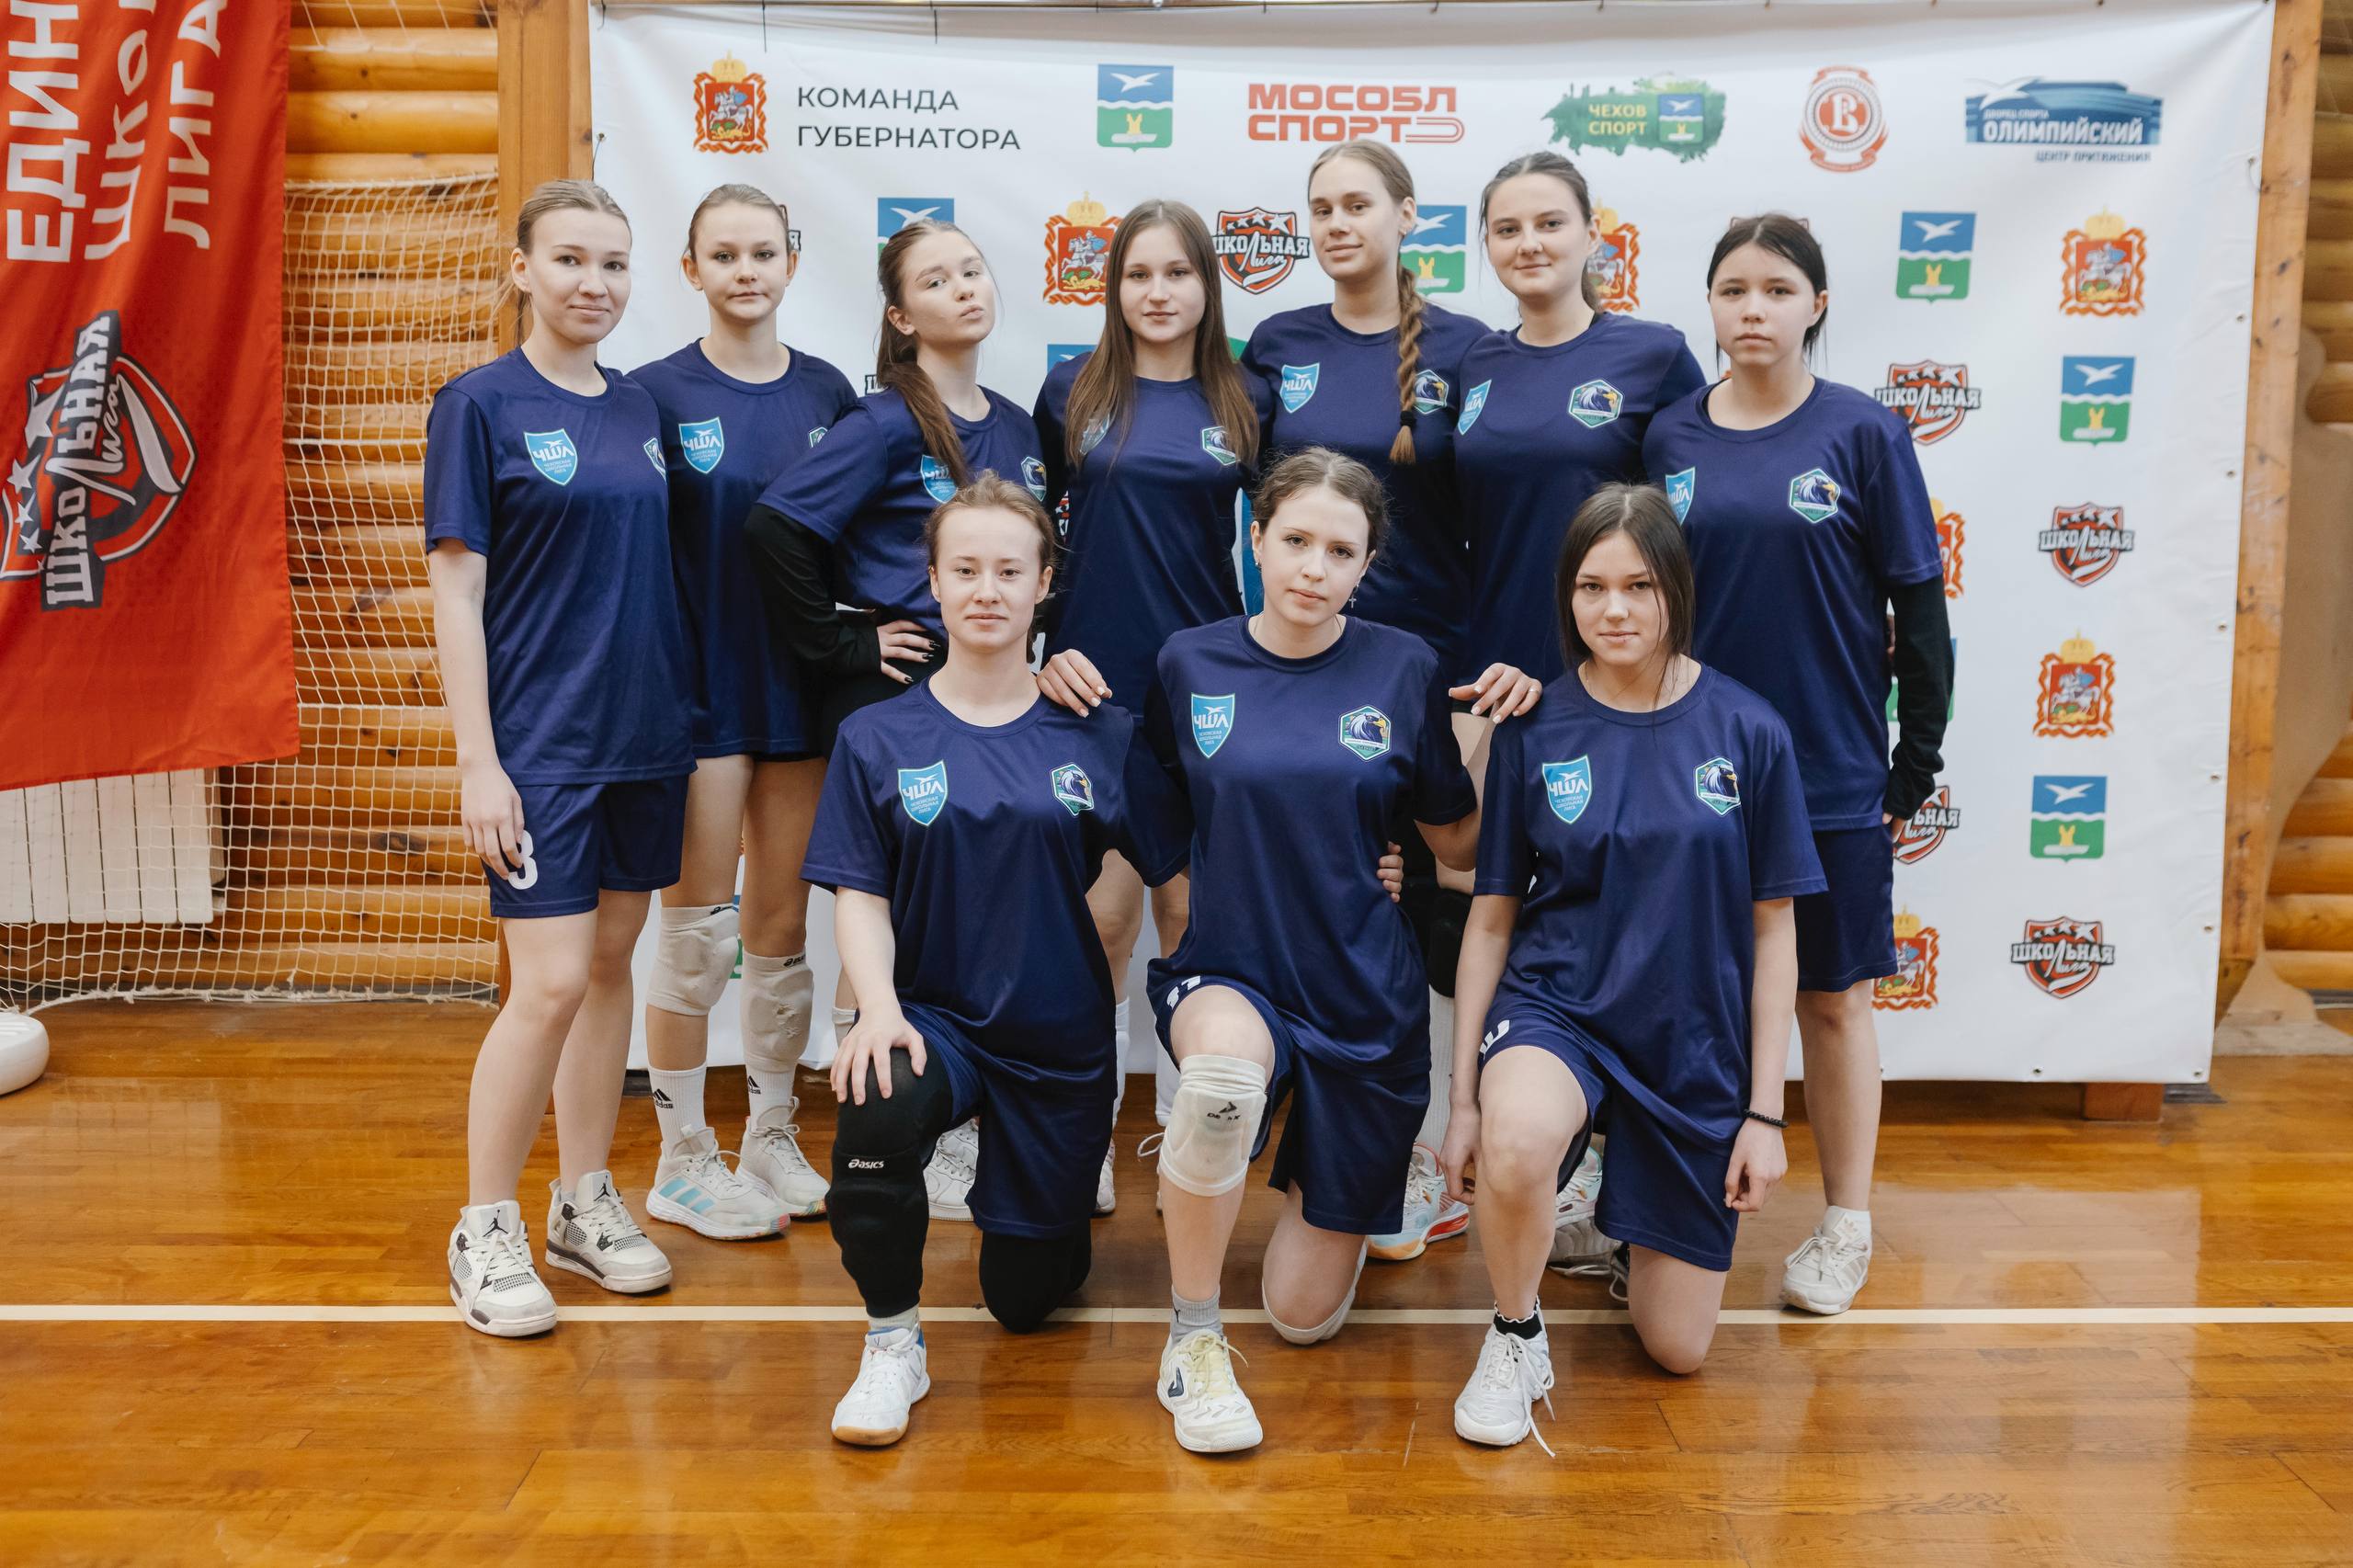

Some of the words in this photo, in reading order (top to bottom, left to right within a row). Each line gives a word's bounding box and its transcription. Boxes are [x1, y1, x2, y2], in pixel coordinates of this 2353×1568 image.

[797, 86, 960, 114] КОМАНДА
[1248, 83, 1457, 112] МОСОБЛ
[1587, 103, 1648, 118] ЧЕХОВ
[84, 0, 157, 260] ШКО
[164, 0, 229, 250] ЛИГА
[1247, 114, 1412, 142] СПОРТ
[1587, 120, 1648, 135] СПОРТ
[1983, 117, 2144, 144] ОЛИМПИЙСКИЙ
[797, 125, 1021, 151] ГУБЕРНАТОРА
[2035, 150, 2071, 163] ЦЕНТР
[2074, 151, 2152, 163] ПРИТЯЖЕНИЯ
[2040, 529, 2134, 551] ШКОЛЬНАЯ
[1193, 713, 1230, 730] ЧШЛ
[902, 780, 945, 801] ЧШЛ
[1548, 778, 1589, 797] ЧШЛ
[2011, 941, 2114, 964] ШКОЛЬНАЯ
